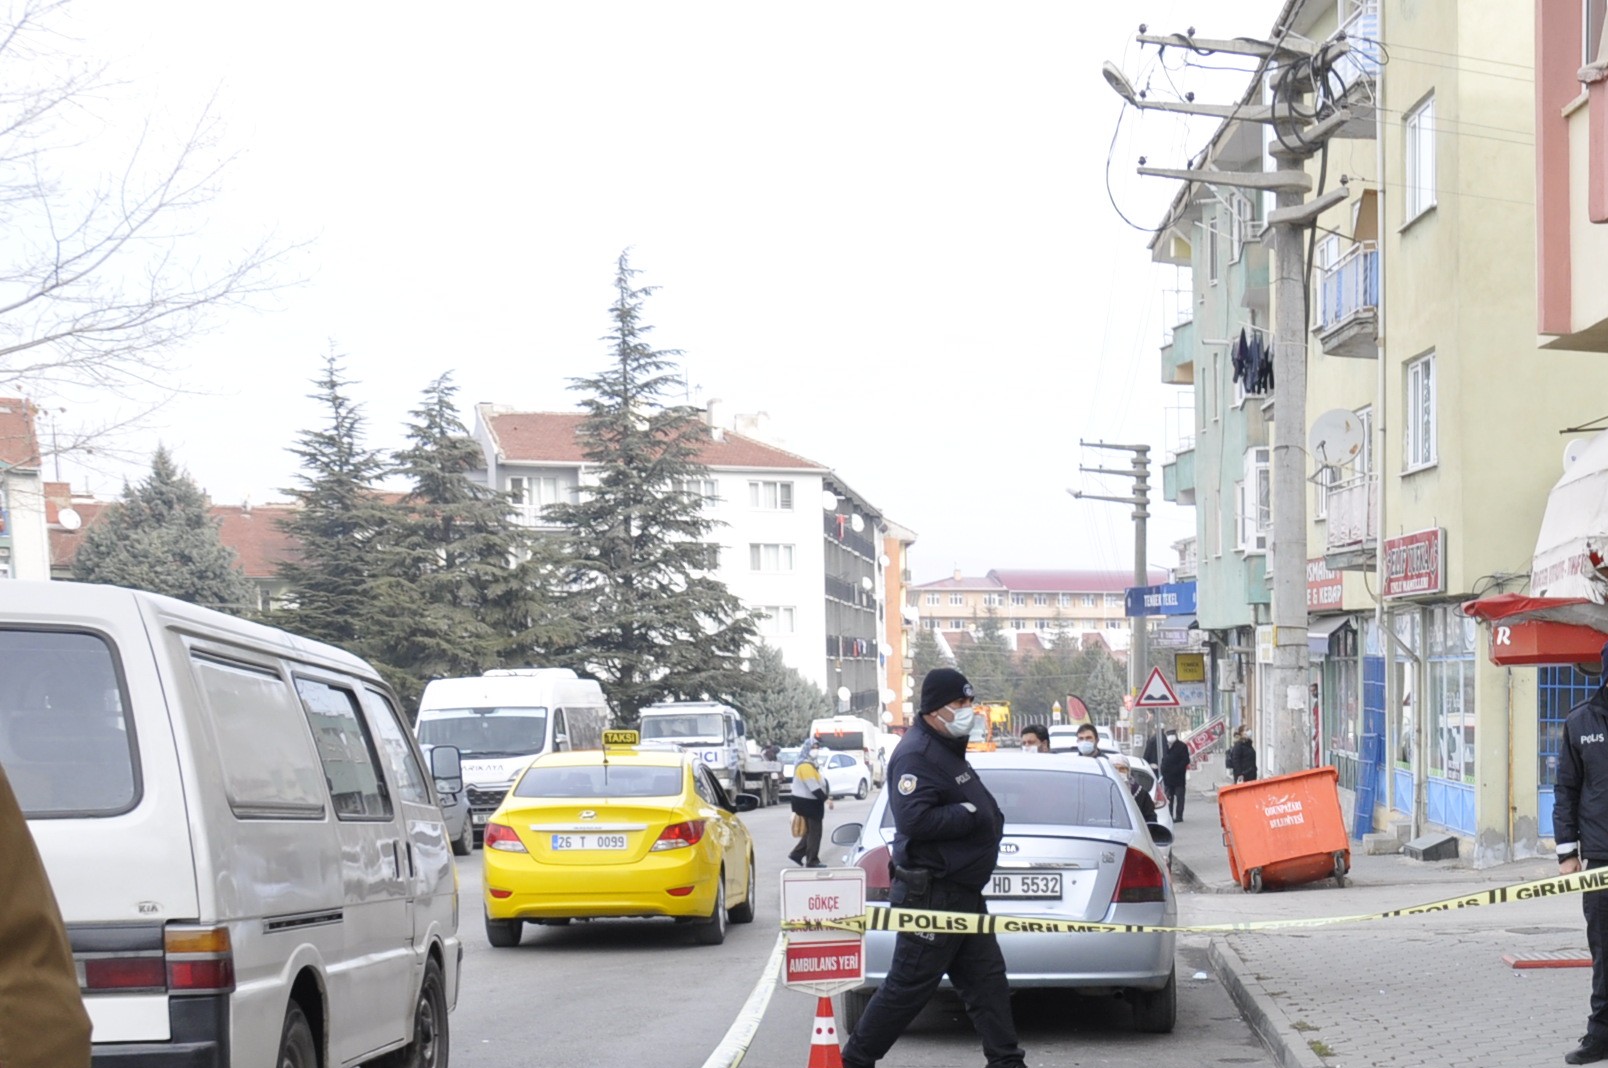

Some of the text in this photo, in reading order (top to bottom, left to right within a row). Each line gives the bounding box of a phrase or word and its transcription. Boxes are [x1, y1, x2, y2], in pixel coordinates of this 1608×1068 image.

[1497, 626, 1511, 645] R
[559, 836, 625, 848] 26 T 0099
[1000, 843, 1017, 853] KIA
[993, 876, 1059, 893] HD 5532
[138, 904, 158, 913] KIA
[808, 895, 839, 912] GÖKÇE
[899, 913, 968, 930] POLİS
[790, 953, 858, 973] AMBULANS YERİ
